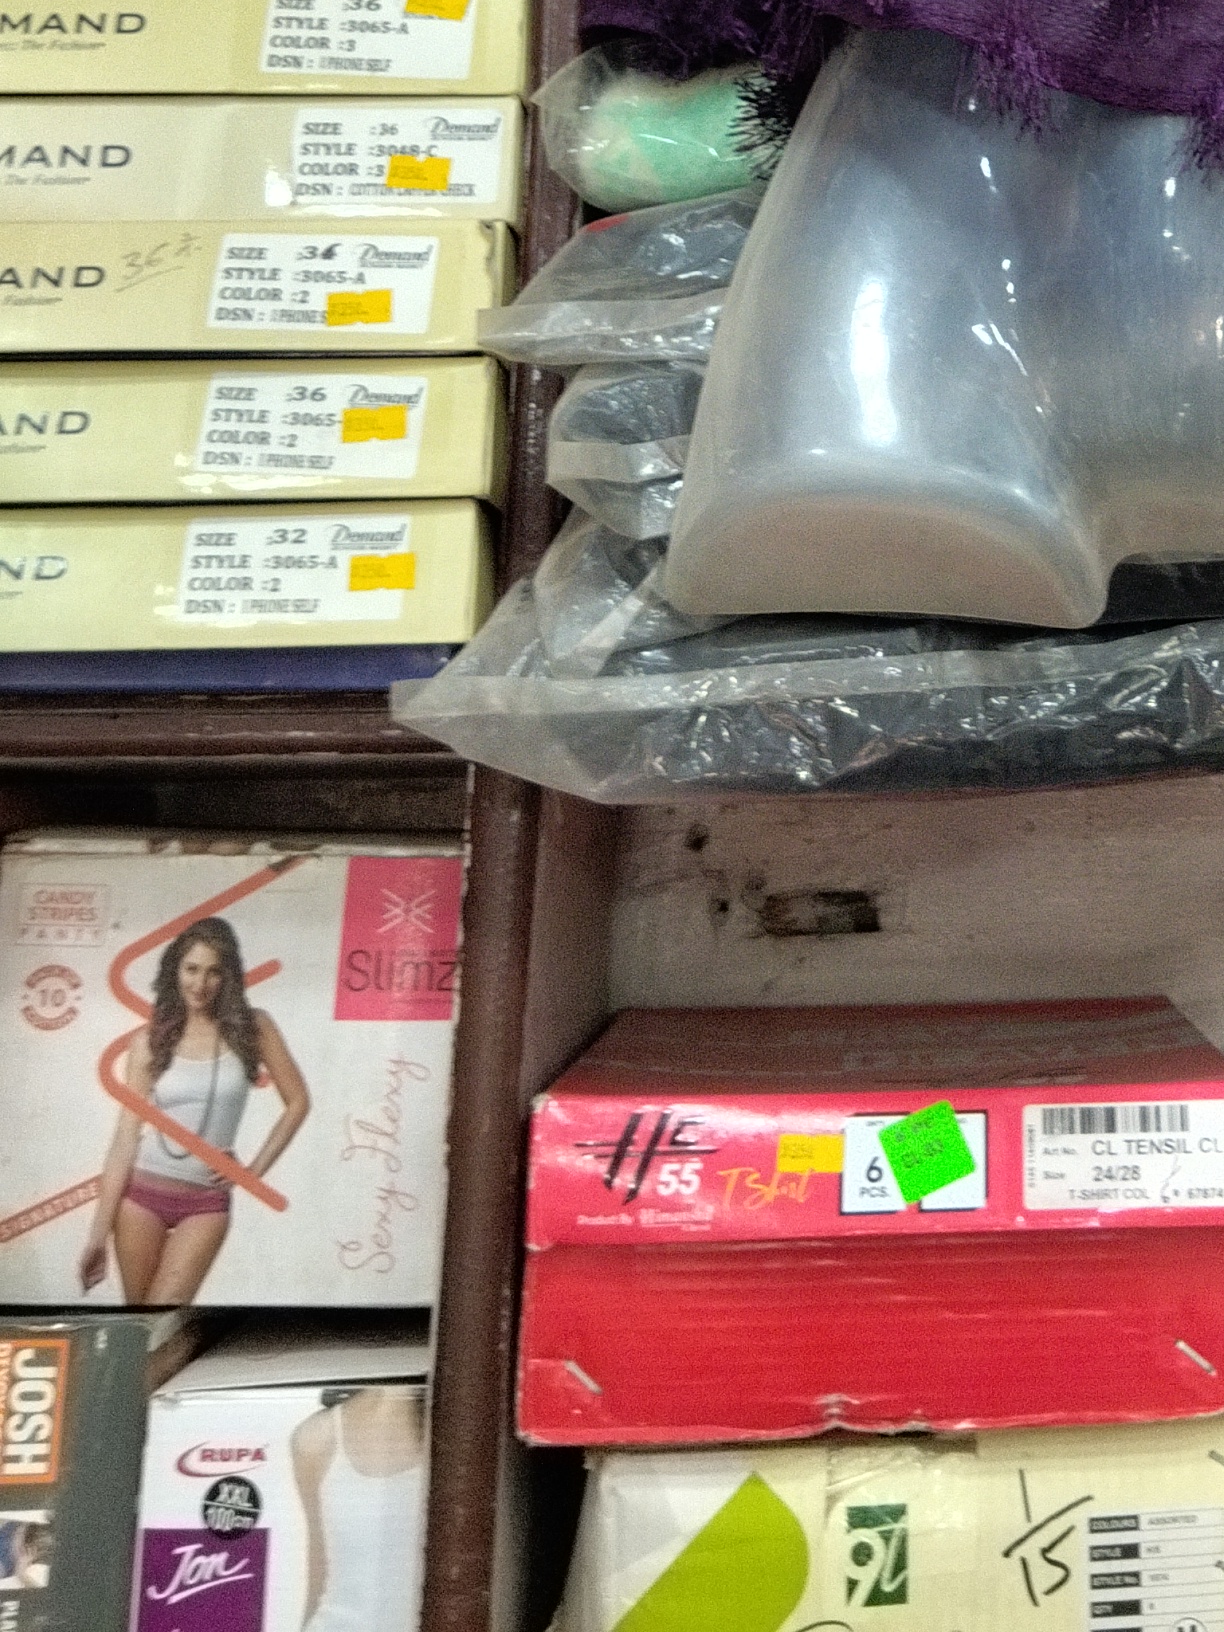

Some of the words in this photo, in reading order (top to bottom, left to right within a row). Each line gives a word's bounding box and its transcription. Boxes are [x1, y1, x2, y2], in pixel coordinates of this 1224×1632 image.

[272, 17, 329, 30] STYLE
[269, 36, 331, 50] COLOR
[302, 122, 343, 136] SIZE
[300, 143, 357, 156] STYLE
[299, 163, 360, 176] COLOR
[227, 247, 269, 260] SIZE
[355, 243, 434, 263] Demand
[222, 267, 282, 281] STYLE
[218, 287, 283, 301] COLOR
[215, 386, 258, 401] SIZE
[0, 410, 92, 435] ND
[211, 408, 270, 423] STYLE
[206, 430, 272, 445] COLOR
[193, 532, 238, 547] SIZE
[191, 554, 253, 569] STYLE
[187, 576, 254, 591] COLOR
[1091, 1140, 1118, 1156] CL
[1124, 1138, 1193, 1156] TENSIL
[1198, 1137, 1224, 1154] CL
[865, 1155, 883, 1183] 6
[656, 1159, 704, 1196] 55
[1, 1347, 59, 1475] JOSH
[200, 1447, 267, 1462] RUPA
